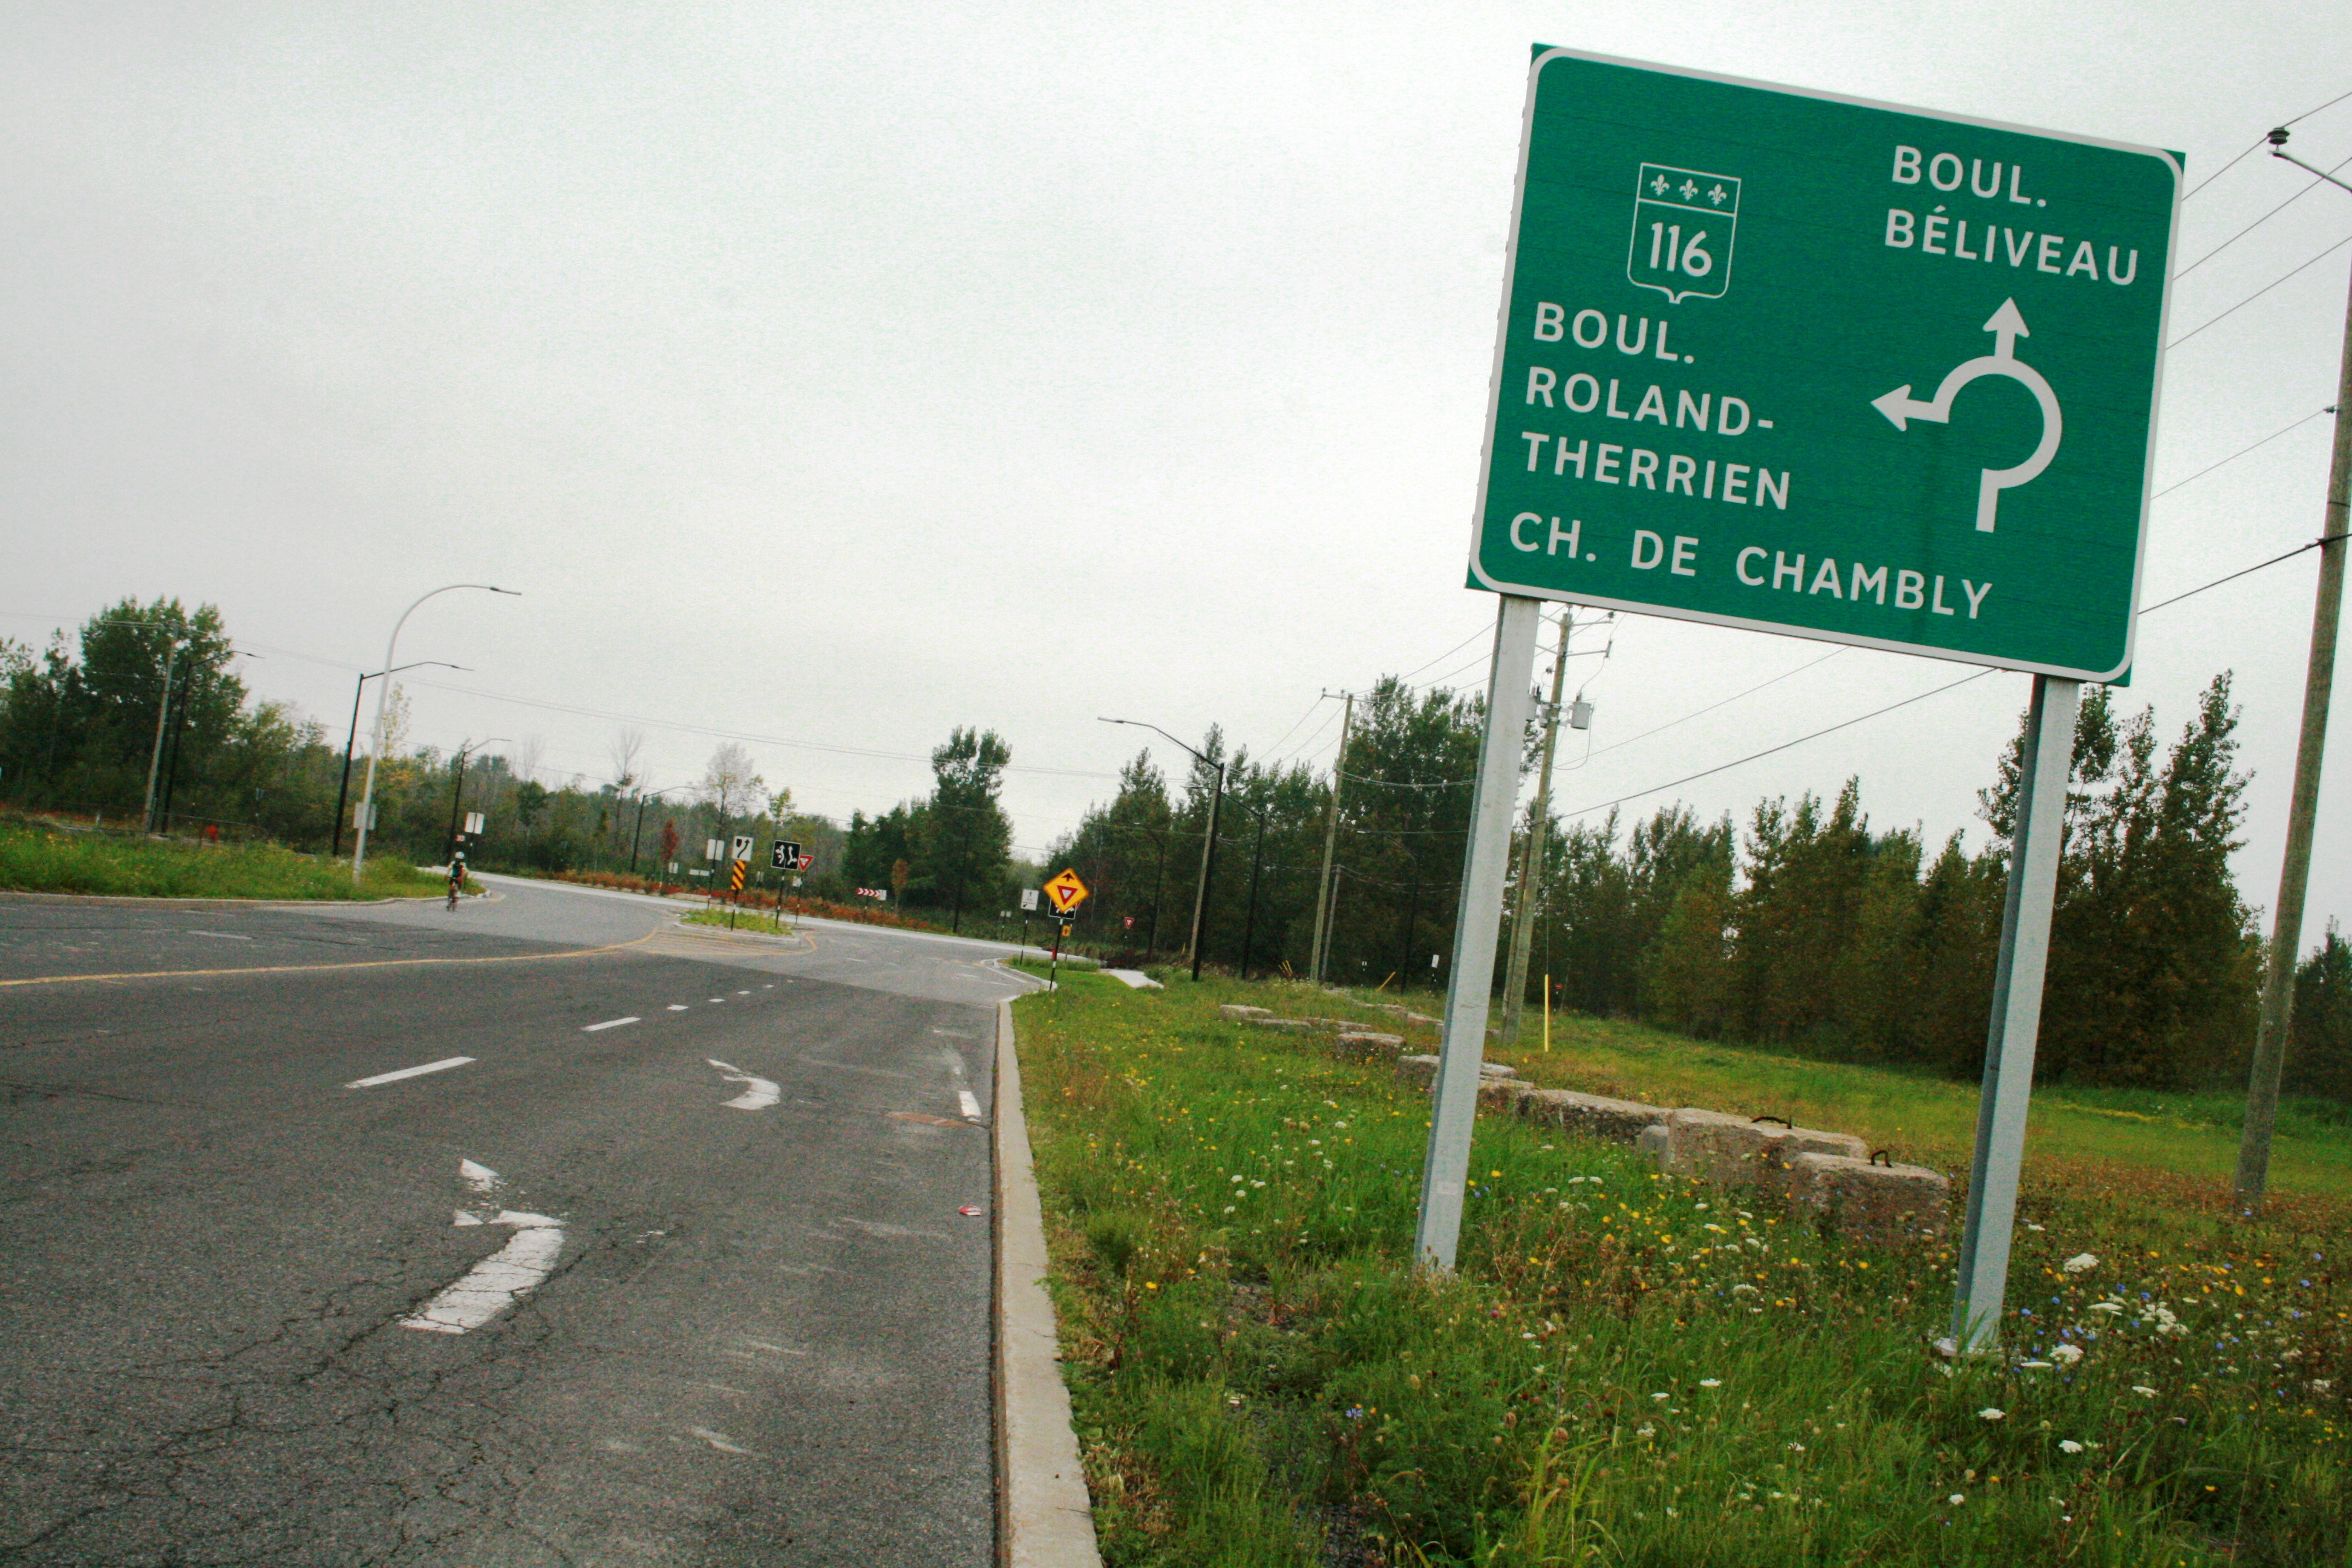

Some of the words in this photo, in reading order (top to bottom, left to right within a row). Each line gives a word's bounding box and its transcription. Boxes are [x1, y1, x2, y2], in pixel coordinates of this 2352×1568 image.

[1893, 145, 2047, 206] BOUL.
[1650, 222, 1712, 276] 116
[1886, 205, 2138, 285] BÉLIVEAU
[1534, 301, 1694, 364] BOUL.
[1526, 366, 1773, 435] ROLAND-
[1522, 431, 1789, 509] THERRIEN
[1510, 512, 1596, 561] CH.
[1631, 529, 1699, 576] DE
[1736, 546, 1993, 619] CHAMBLY
